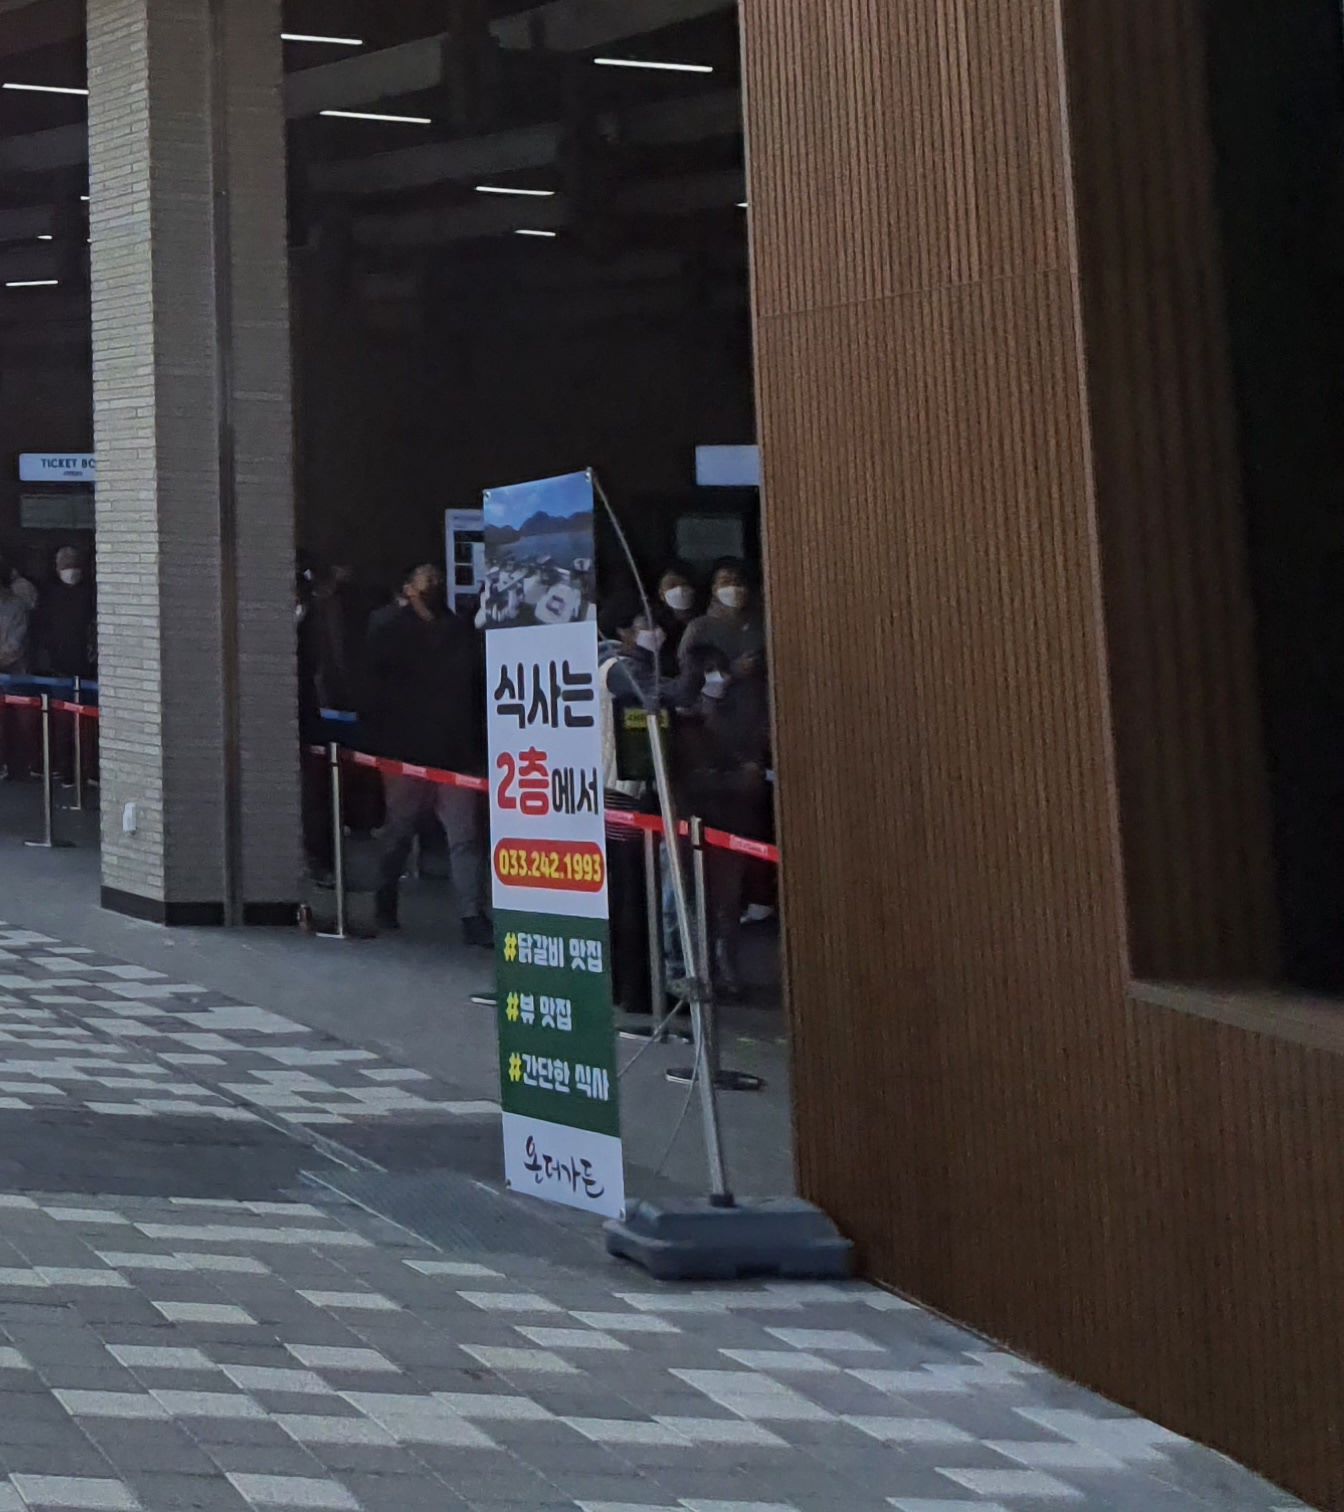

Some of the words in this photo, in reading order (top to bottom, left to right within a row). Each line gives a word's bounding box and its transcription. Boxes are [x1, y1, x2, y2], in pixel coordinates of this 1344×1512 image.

[40, 458, 77, 469] TICKET
[81, 458, 96, 469] BO
[494, 660, 595, 729] 식사는
[496, 746, 599, 816] 2층에서
[499, 848, 602, 882] 033.242.1993
[504, 931, 564, 968] #닭갈비
[569, 939, 603, 973] 맛집
[506, 992, 535, 1025] #뷰
[539, 995, 572, 1031] 맛집
[508, 1052, 571, 1094] #간단한
[574, 1063, 610, 1101] 식사
